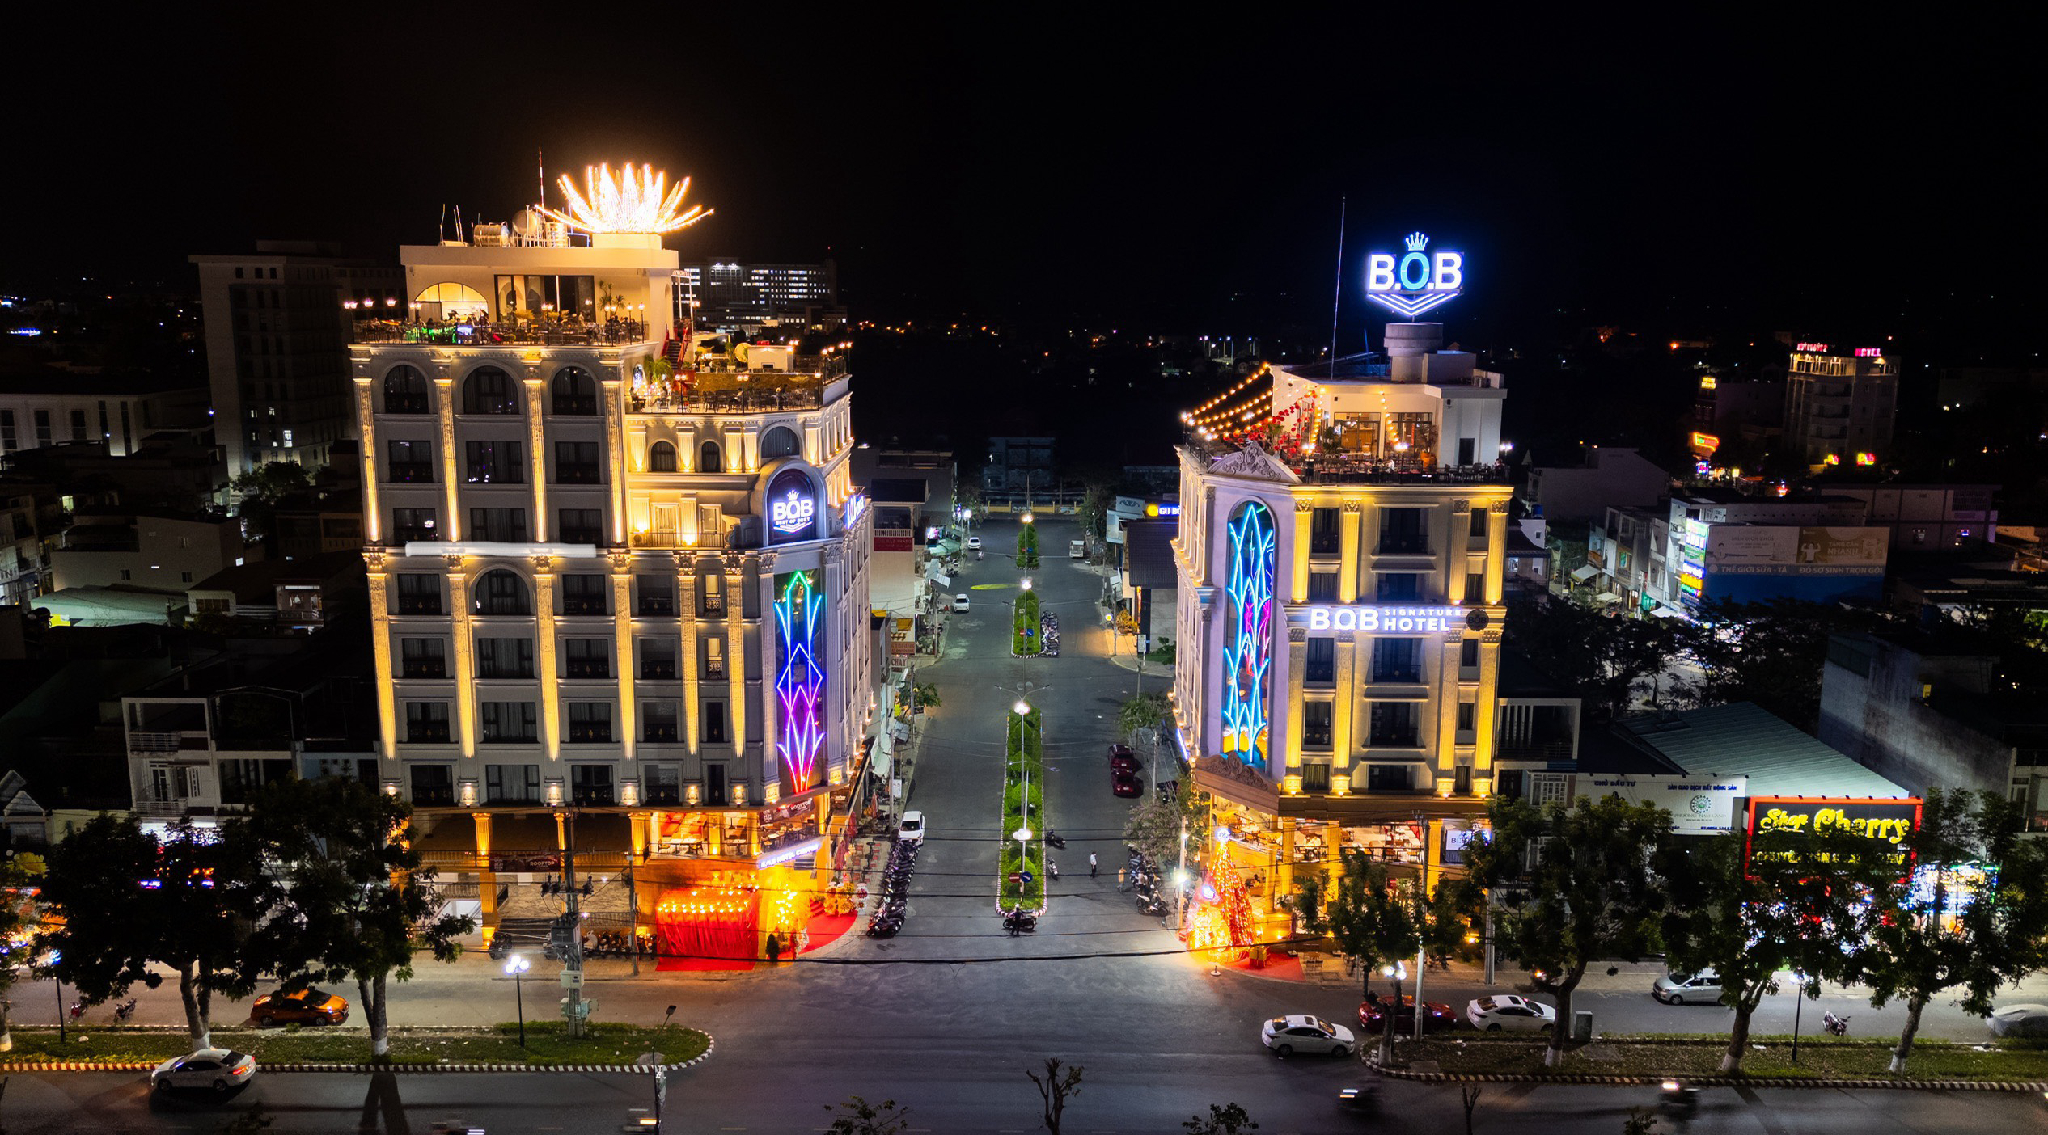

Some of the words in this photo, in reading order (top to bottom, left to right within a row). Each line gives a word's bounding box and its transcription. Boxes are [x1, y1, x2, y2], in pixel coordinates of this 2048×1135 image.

[1368, 251, 1463, 290] B.O.B
[772, 499, 814, 521] BOB
[1309, 608, 1379, 631] BOB
[1384, 617, 1450, 632] HOTEL
[1384, 609, 1462, 617] SIGNATURE
[1813, 808, 1910, 844] Cherry
